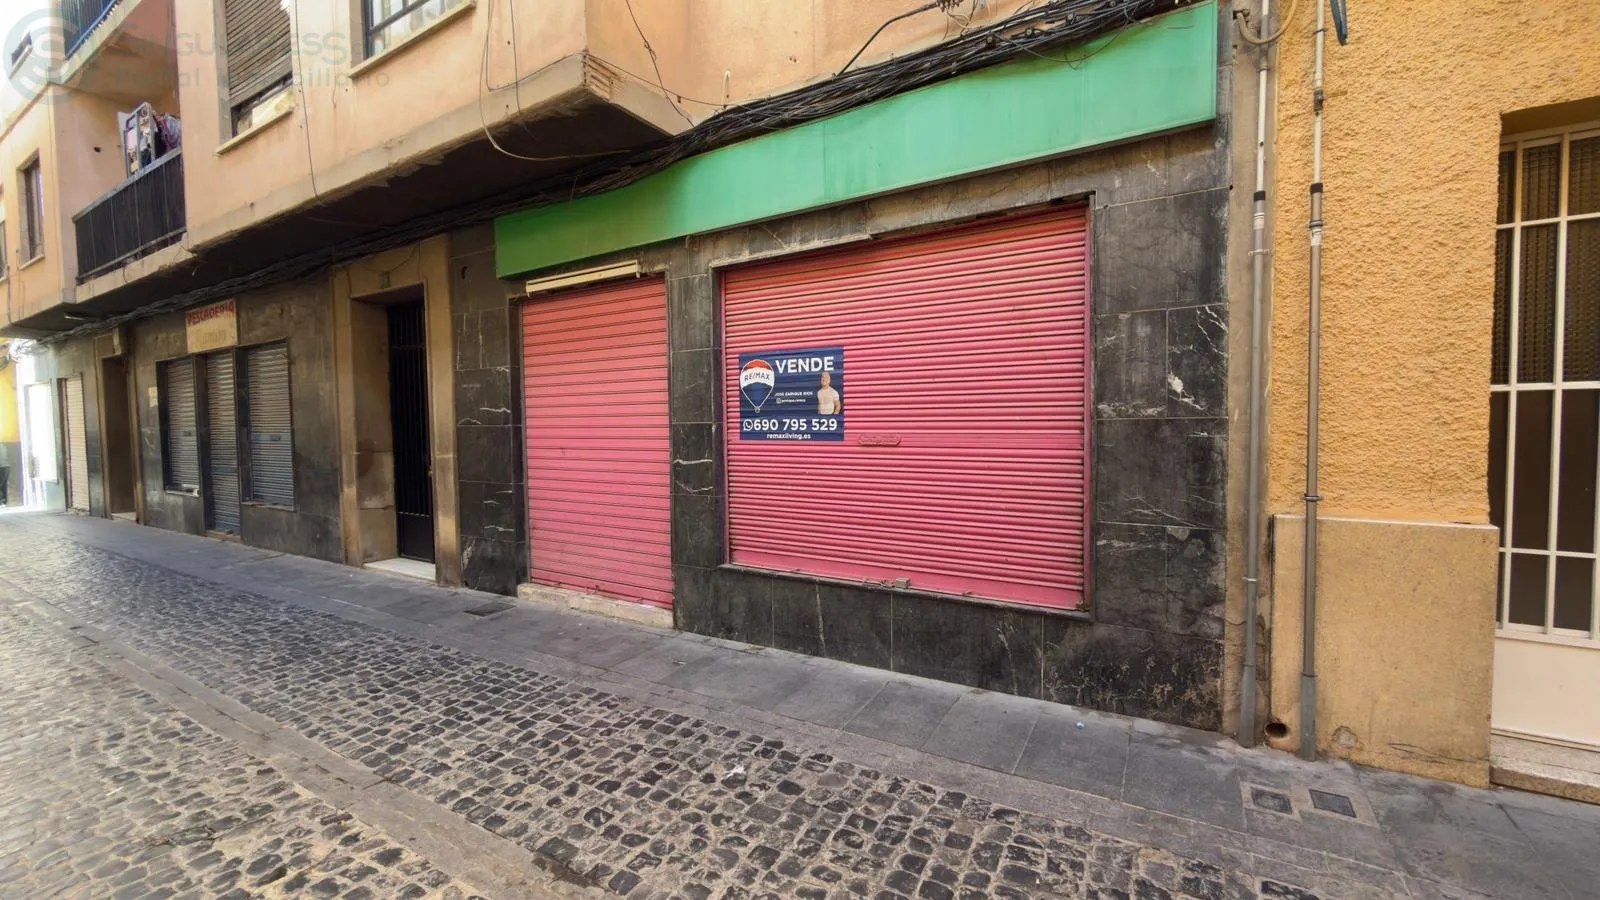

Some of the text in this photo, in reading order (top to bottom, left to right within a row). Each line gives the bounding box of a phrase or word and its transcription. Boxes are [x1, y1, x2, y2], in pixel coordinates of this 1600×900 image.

[775, 356, 834, 374] VENDE
[744, 372, 770, 381] RE/MAX
[754, 418, 837, 431] 690 795 529
